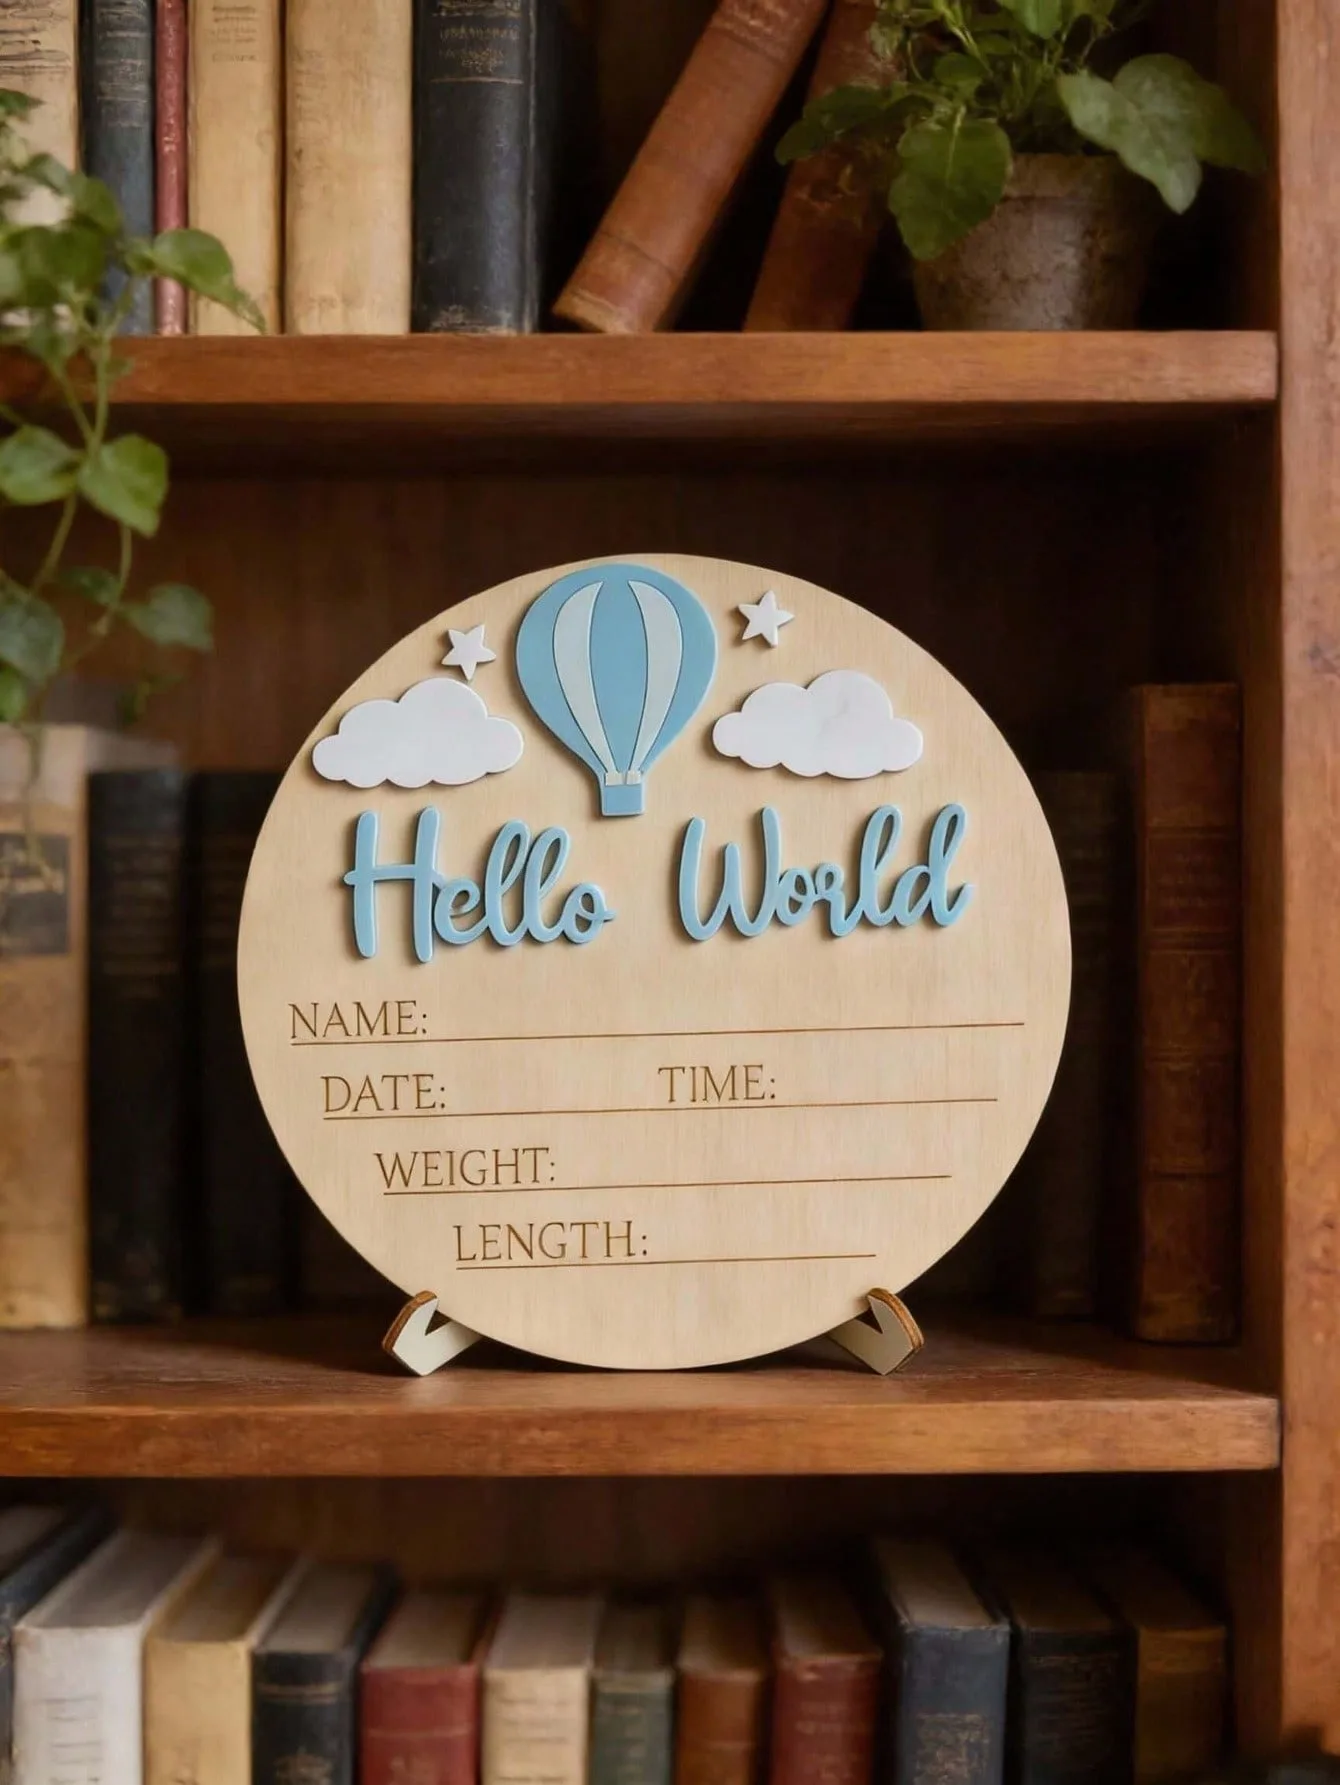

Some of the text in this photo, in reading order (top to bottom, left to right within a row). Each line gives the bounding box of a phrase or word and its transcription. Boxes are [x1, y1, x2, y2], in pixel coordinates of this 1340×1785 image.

[343, 803, 976, 963] Hello World
[289, 1000, 428, 1039] NAME:
[321, 1063, 777, 1113] DATE: TIME:
[374, 1147, 556, 1190] WEIGHT:
[453, 1220, 648, 1262] LENGTH:
